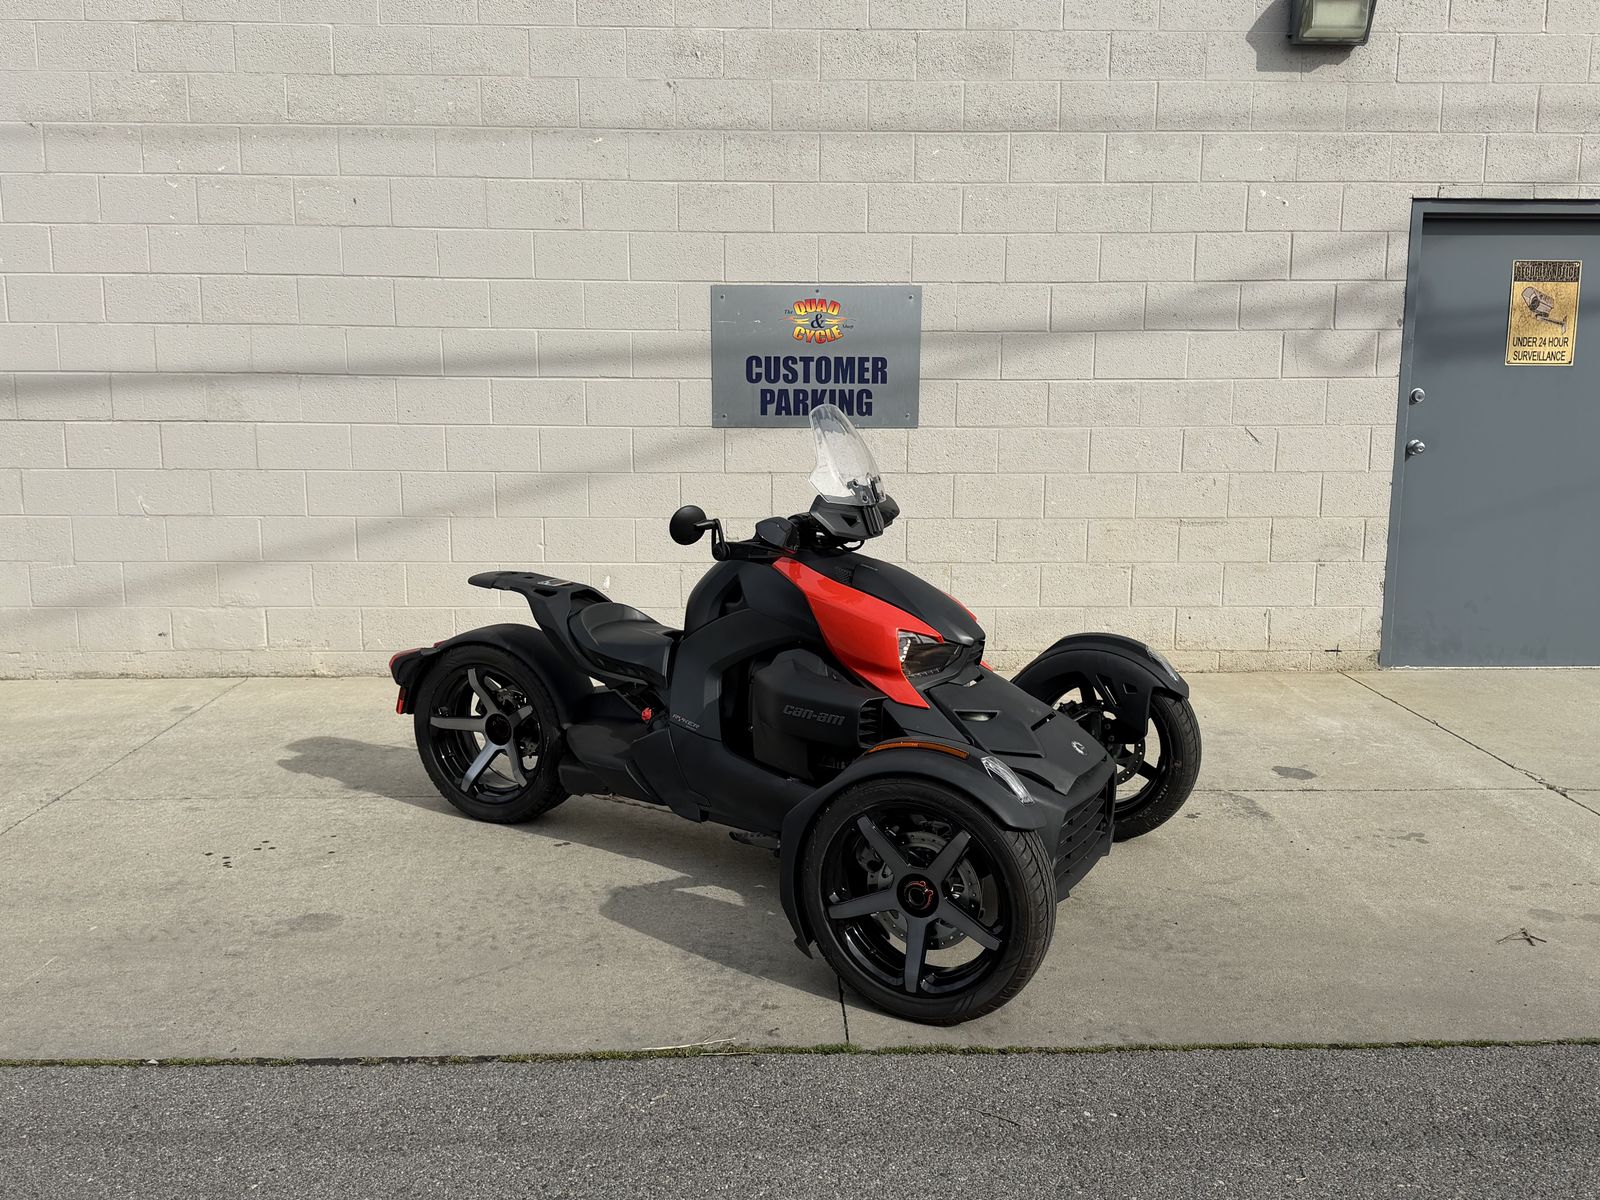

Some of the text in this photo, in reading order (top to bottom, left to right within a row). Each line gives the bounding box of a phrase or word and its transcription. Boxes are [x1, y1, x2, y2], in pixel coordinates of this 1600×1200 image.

[793, 298, 841, 315] QUAD
[810, 313, 825, 329] &
[792, 325, 843, 344] CYCLE
[1513, 337, 1569, 347] UNDER 24 HOUR
[1513, 351, 1565, 361] SURVEILLANCE
[745, 355, 888, 384] CUSTOMER
